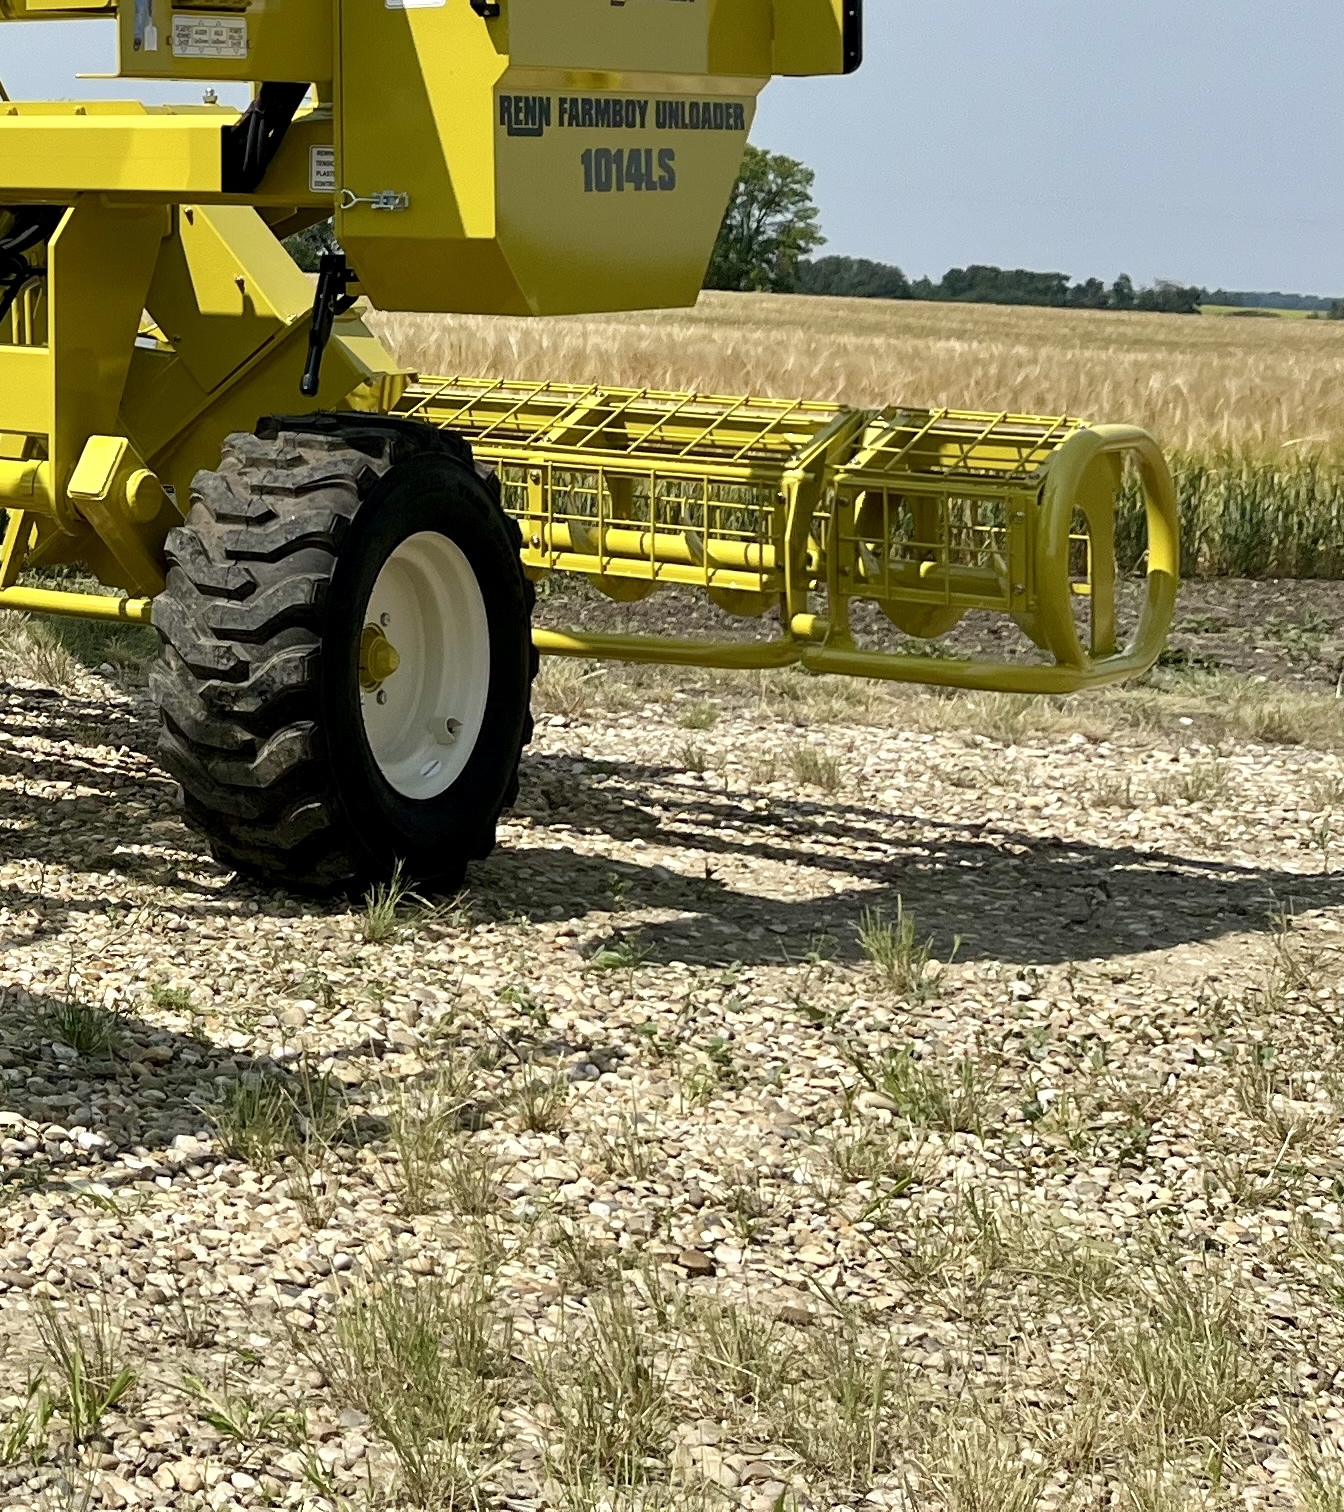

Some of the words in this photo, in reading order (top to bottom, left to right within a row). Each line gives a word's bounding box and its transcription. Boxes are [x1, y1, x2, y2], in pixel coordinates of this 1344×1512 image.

[499, 95, 551, 137] RENN
[558, 97, 649, 129] FARMBOY
[655, 100, 745, 131] UNLOADER
[580, 147, 677, 192] 1014LS
